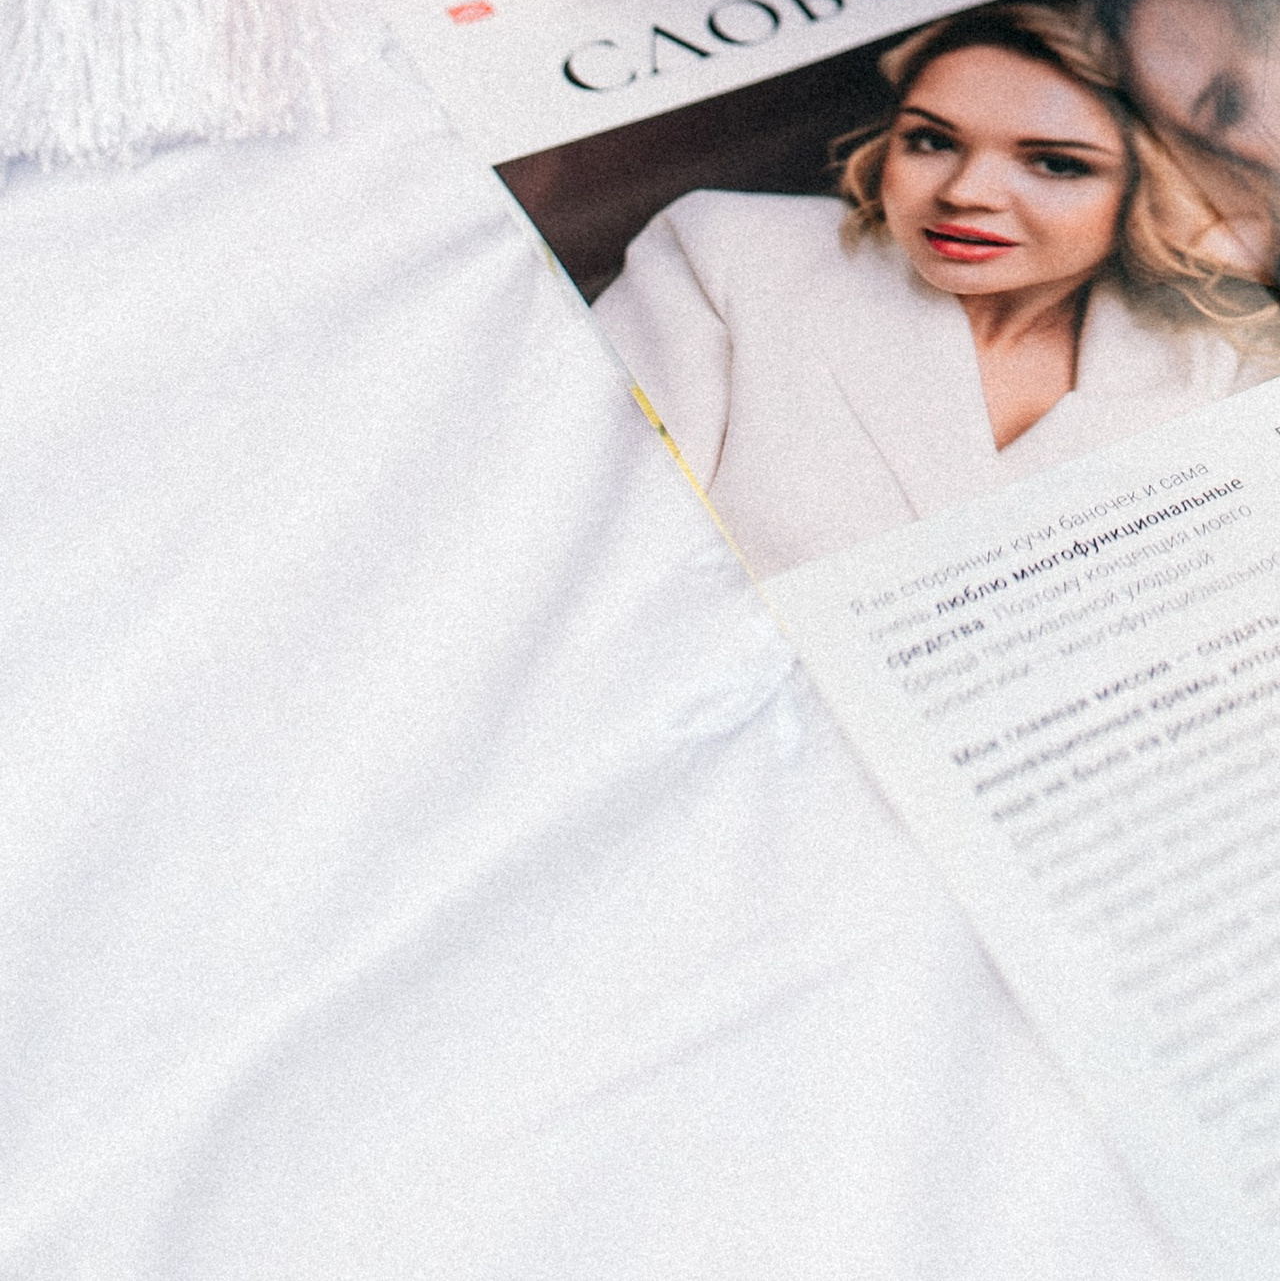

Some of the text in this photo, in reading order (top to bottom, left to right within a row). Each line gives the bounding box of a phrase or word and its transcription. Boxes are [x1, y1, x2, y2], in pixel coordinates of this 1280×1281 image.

[933, 478, 1246, 615] люблю многофункциональные
[1008, 525, 1059, 552] кучи
[1055, 491, 1142, 532] баночек
[1158, 463, 1210, 490] сама
